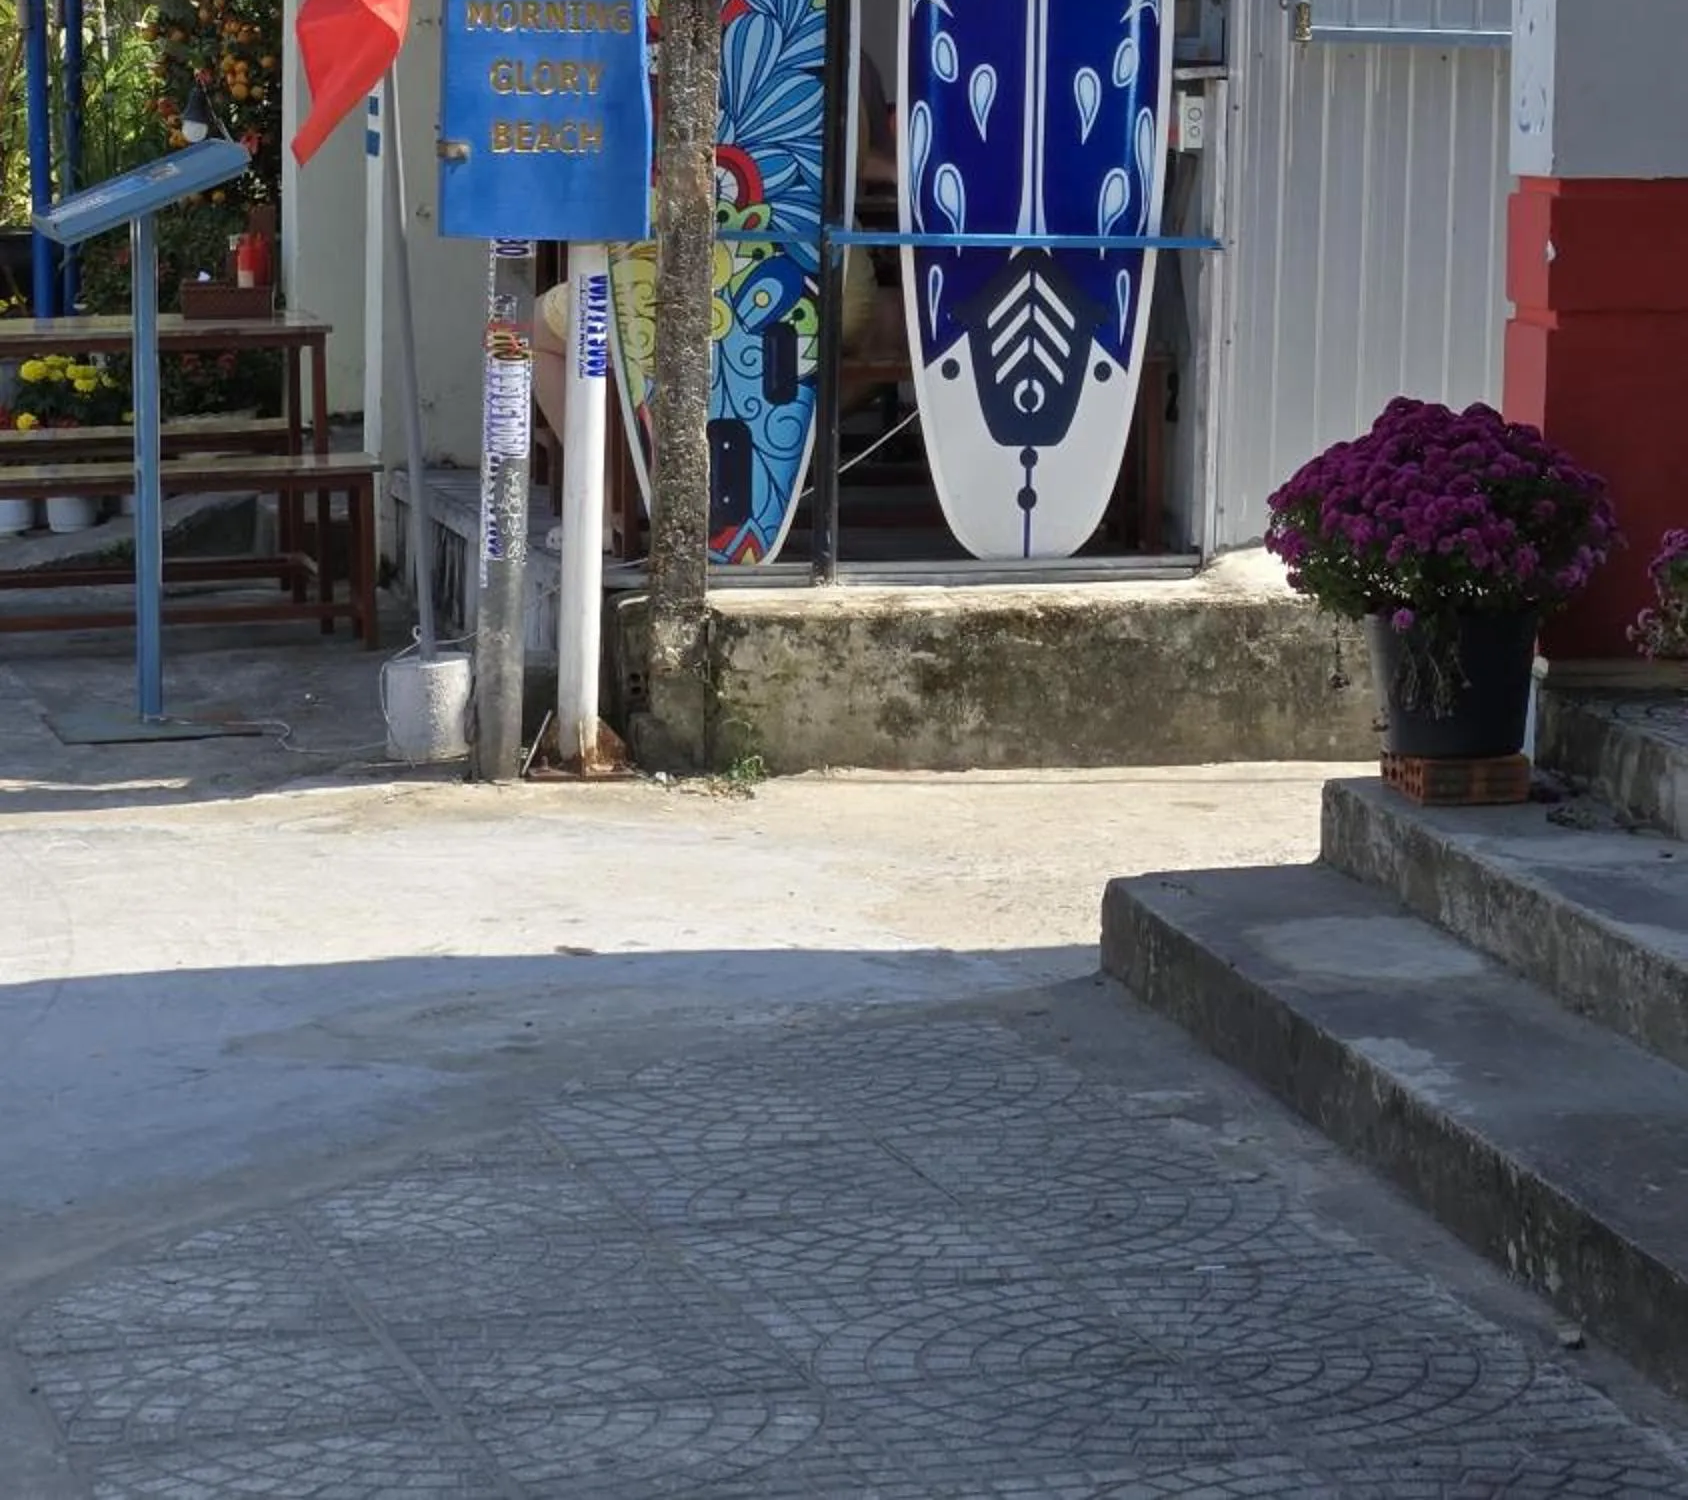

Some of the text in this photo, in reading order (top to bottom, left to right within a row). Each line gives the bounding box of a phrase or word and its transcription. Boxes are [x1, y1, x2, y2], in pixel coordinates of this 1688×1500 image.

[466, 0, 633, 34] MORNING
[490, 61, 603, 94] GLORY
[491, 122, 603, 153] BEACH
